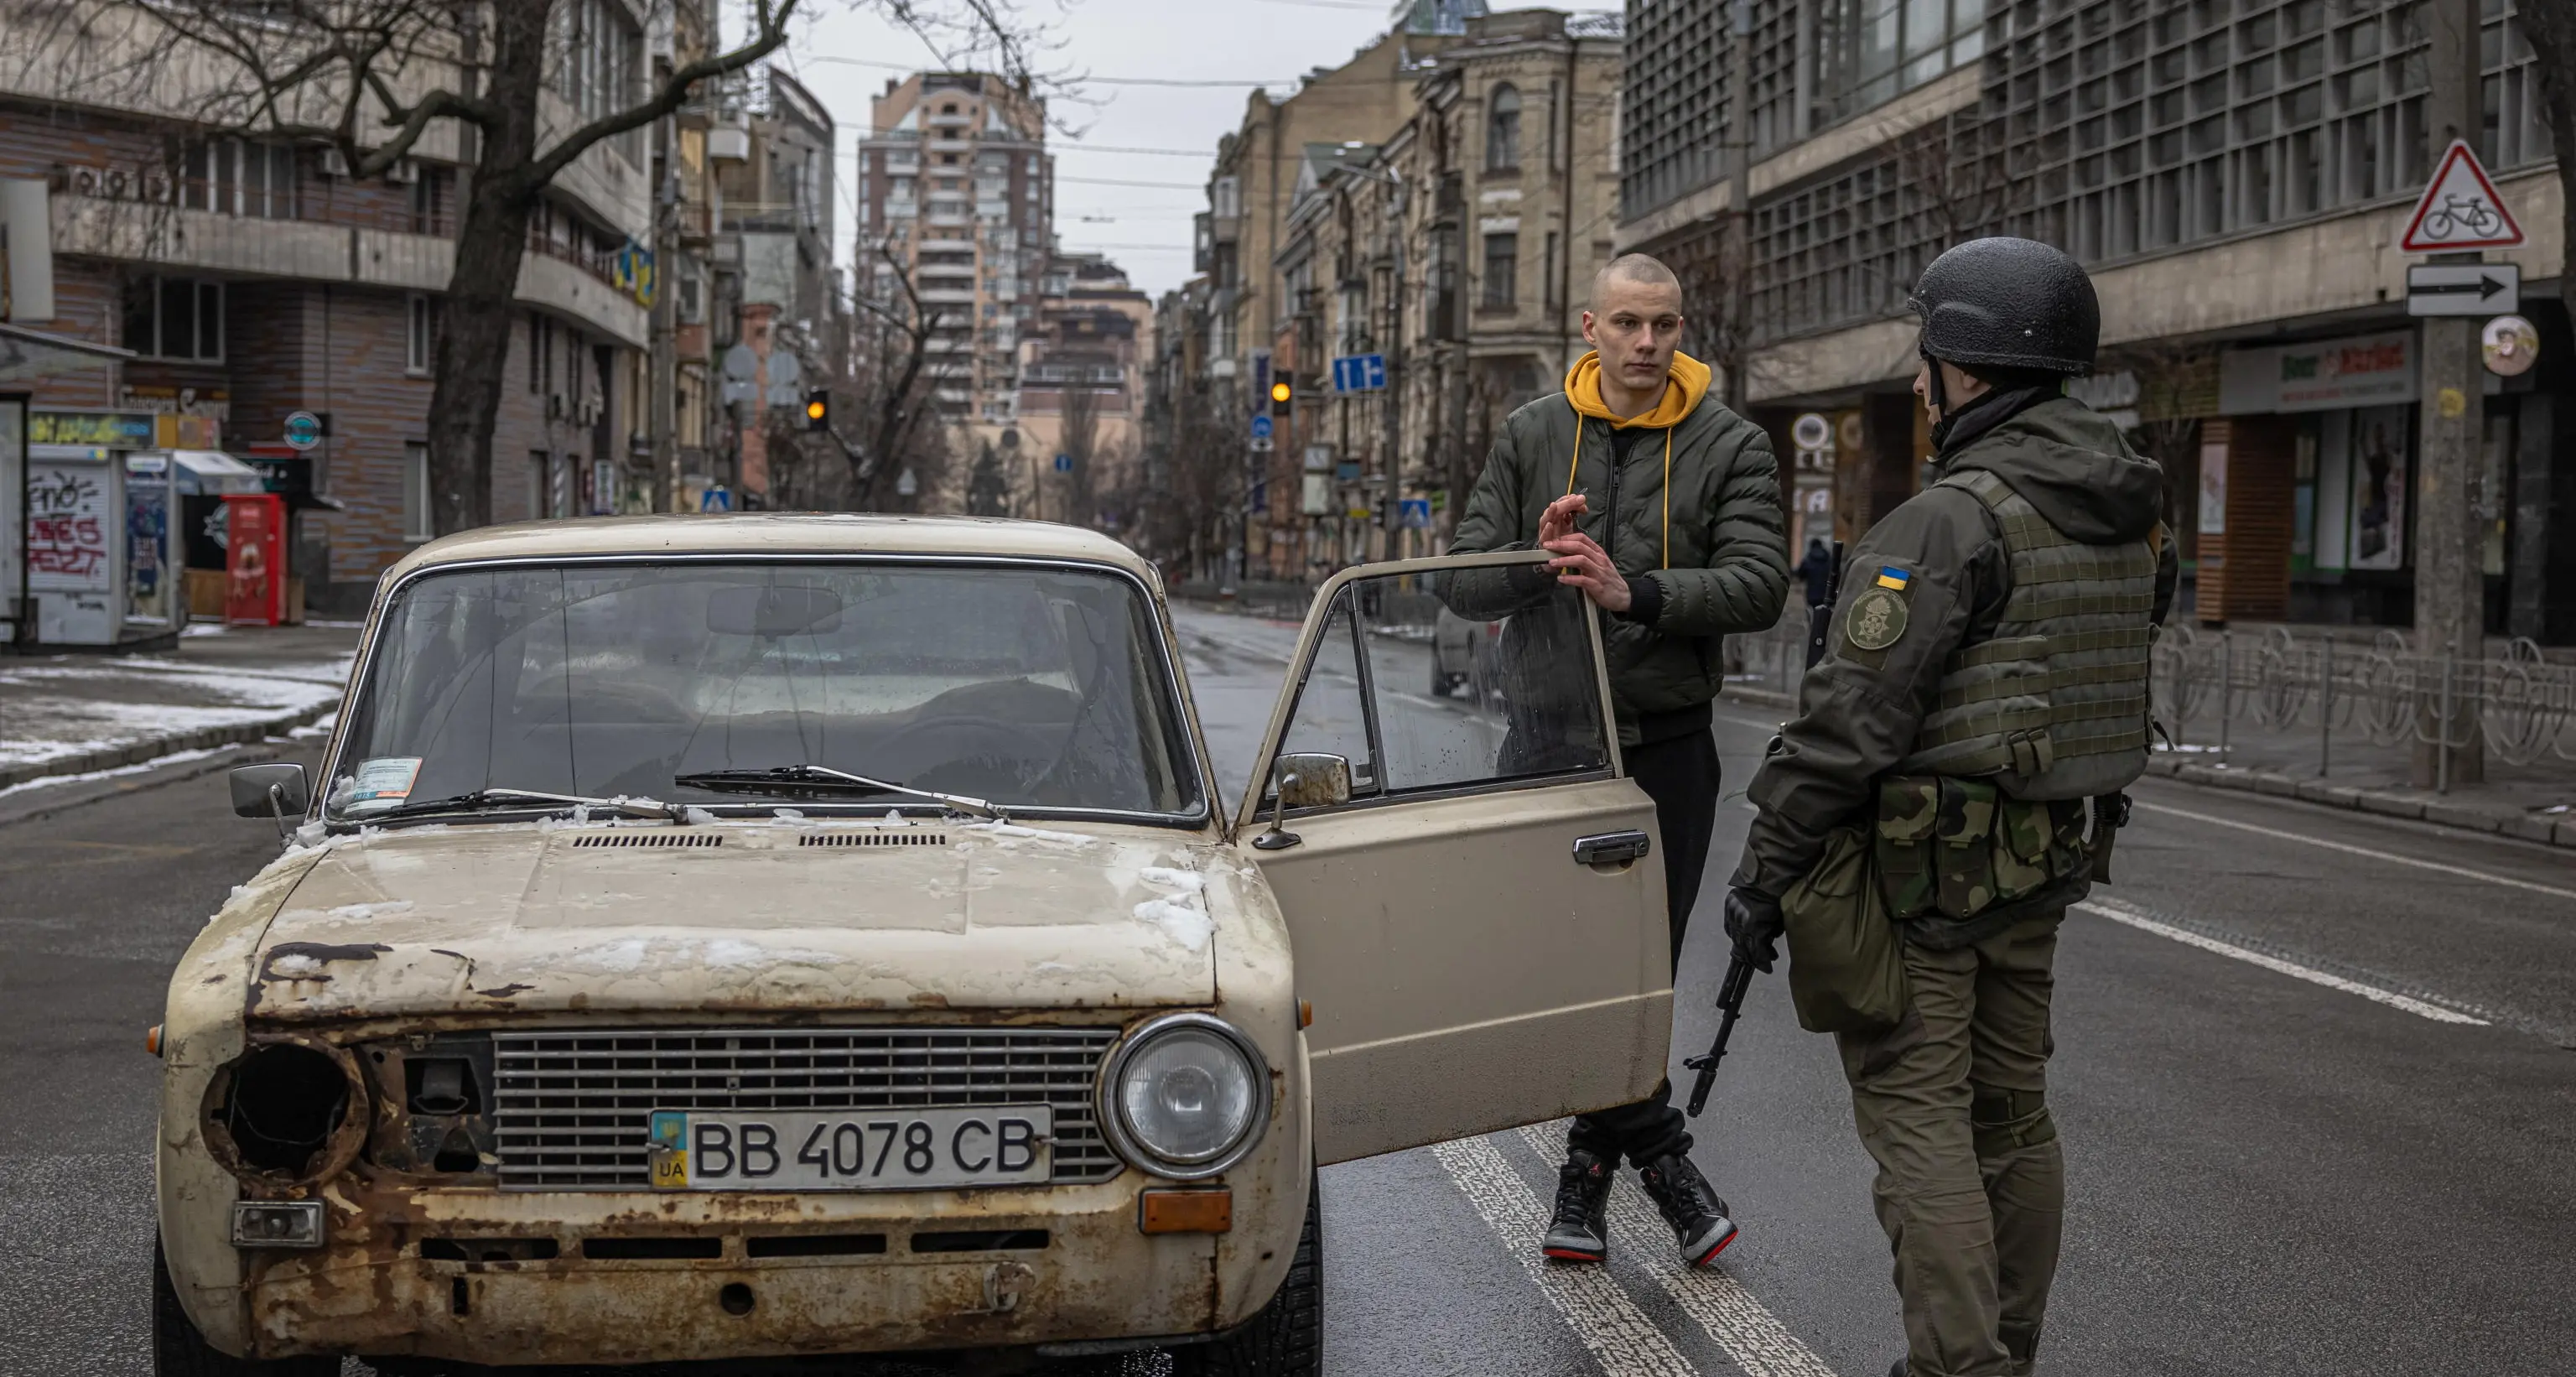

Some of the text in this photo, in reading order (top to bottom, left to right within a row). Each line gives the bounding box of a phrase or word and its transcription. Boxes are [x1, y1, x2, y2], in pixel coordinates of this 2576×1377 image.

[694, 1119, 1036, 1177] BB 4078 CB
[659, 1162, 684, 1177] UA
